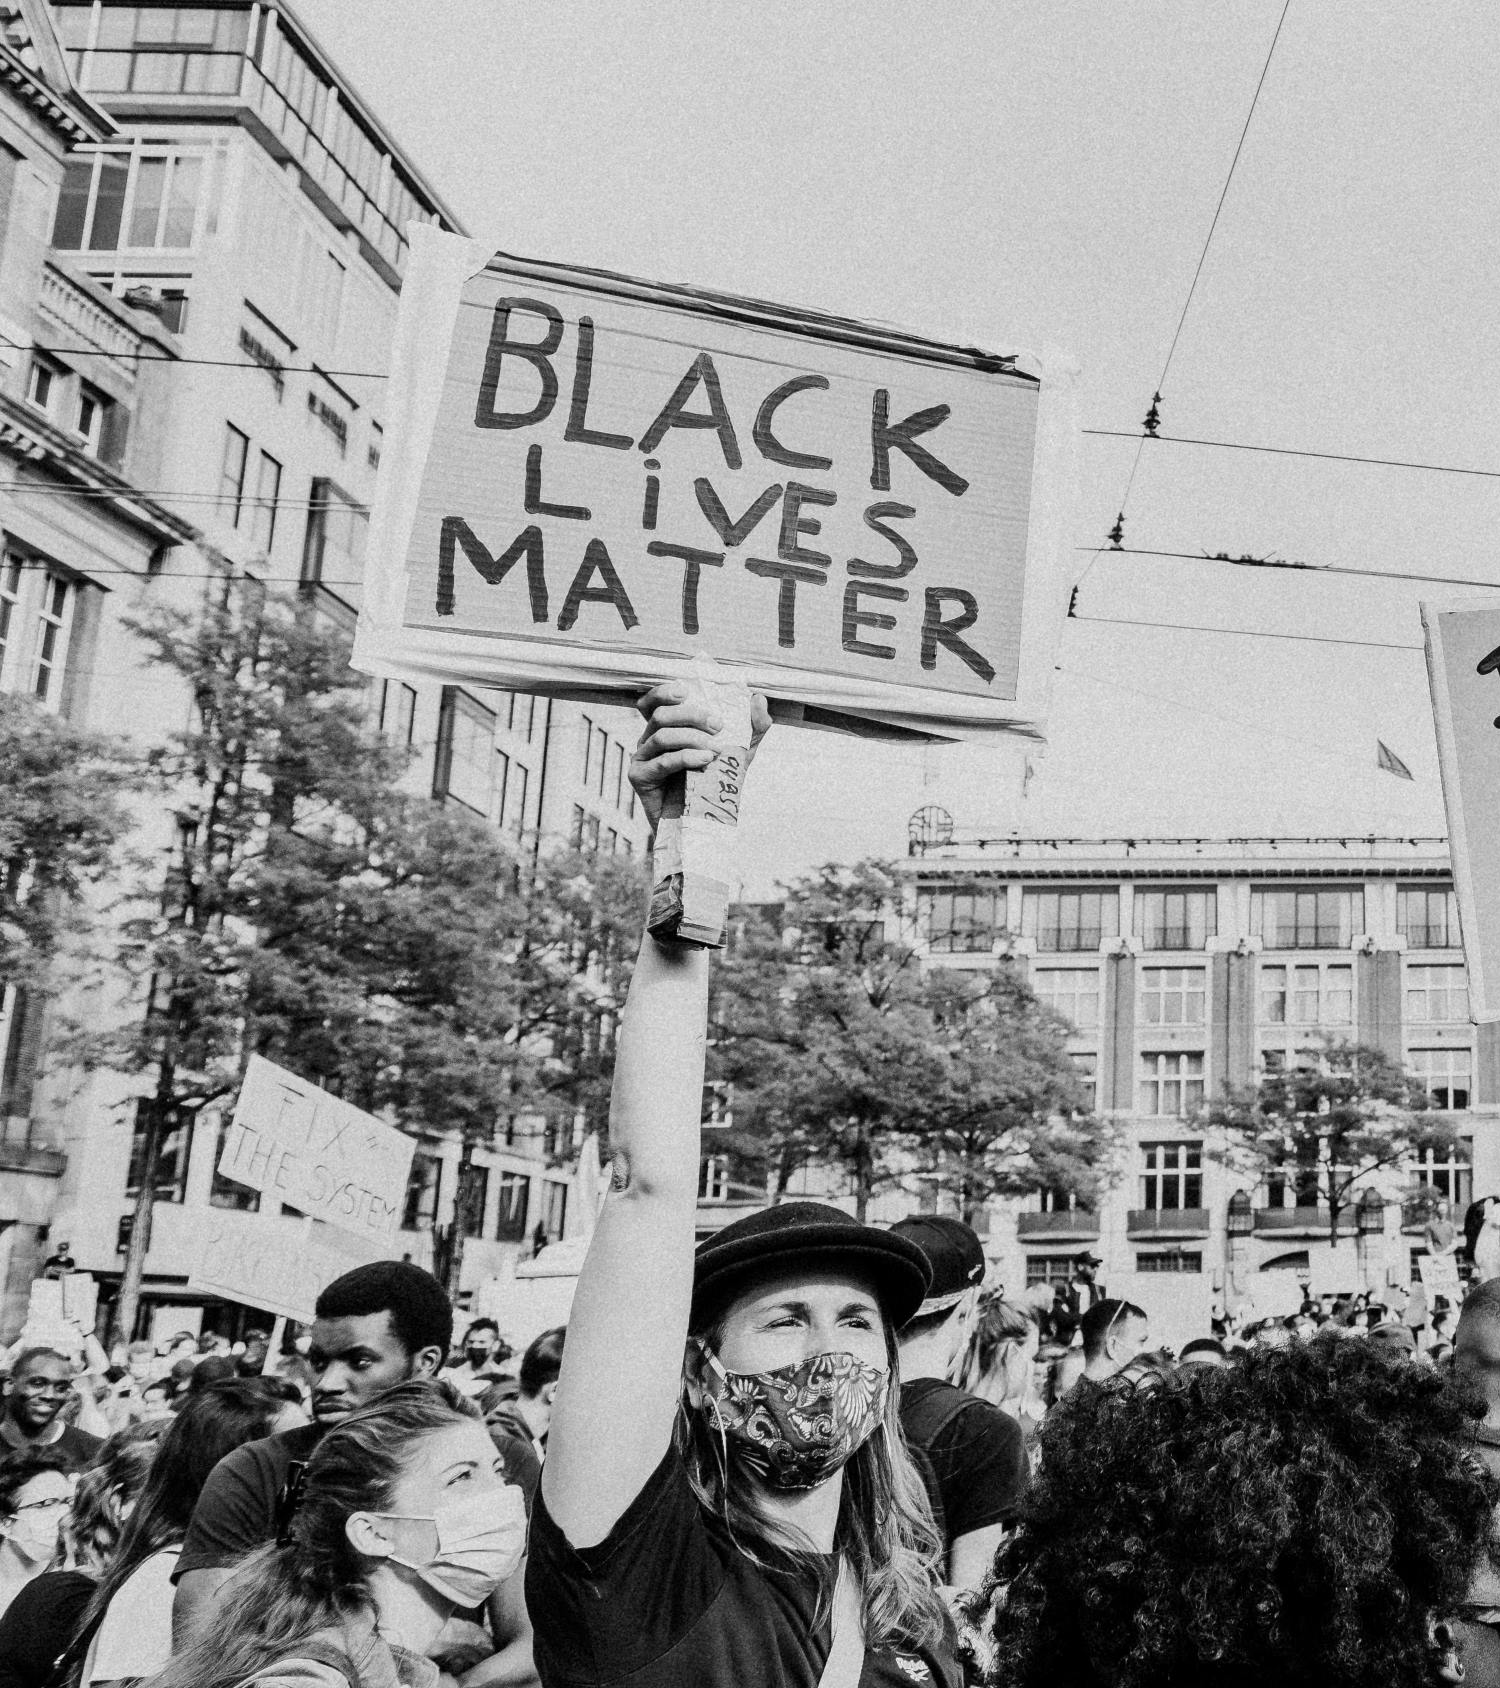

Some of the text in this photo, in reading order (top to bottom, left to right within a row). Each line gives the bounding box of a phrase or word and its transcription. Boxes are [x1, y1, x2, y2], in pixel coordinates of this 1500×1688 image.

[474, 297, 970, 495] BLACK
[435, 516, 996, 684] MATTER
[233, 1123, 396, 1232] THE SYSTEM
